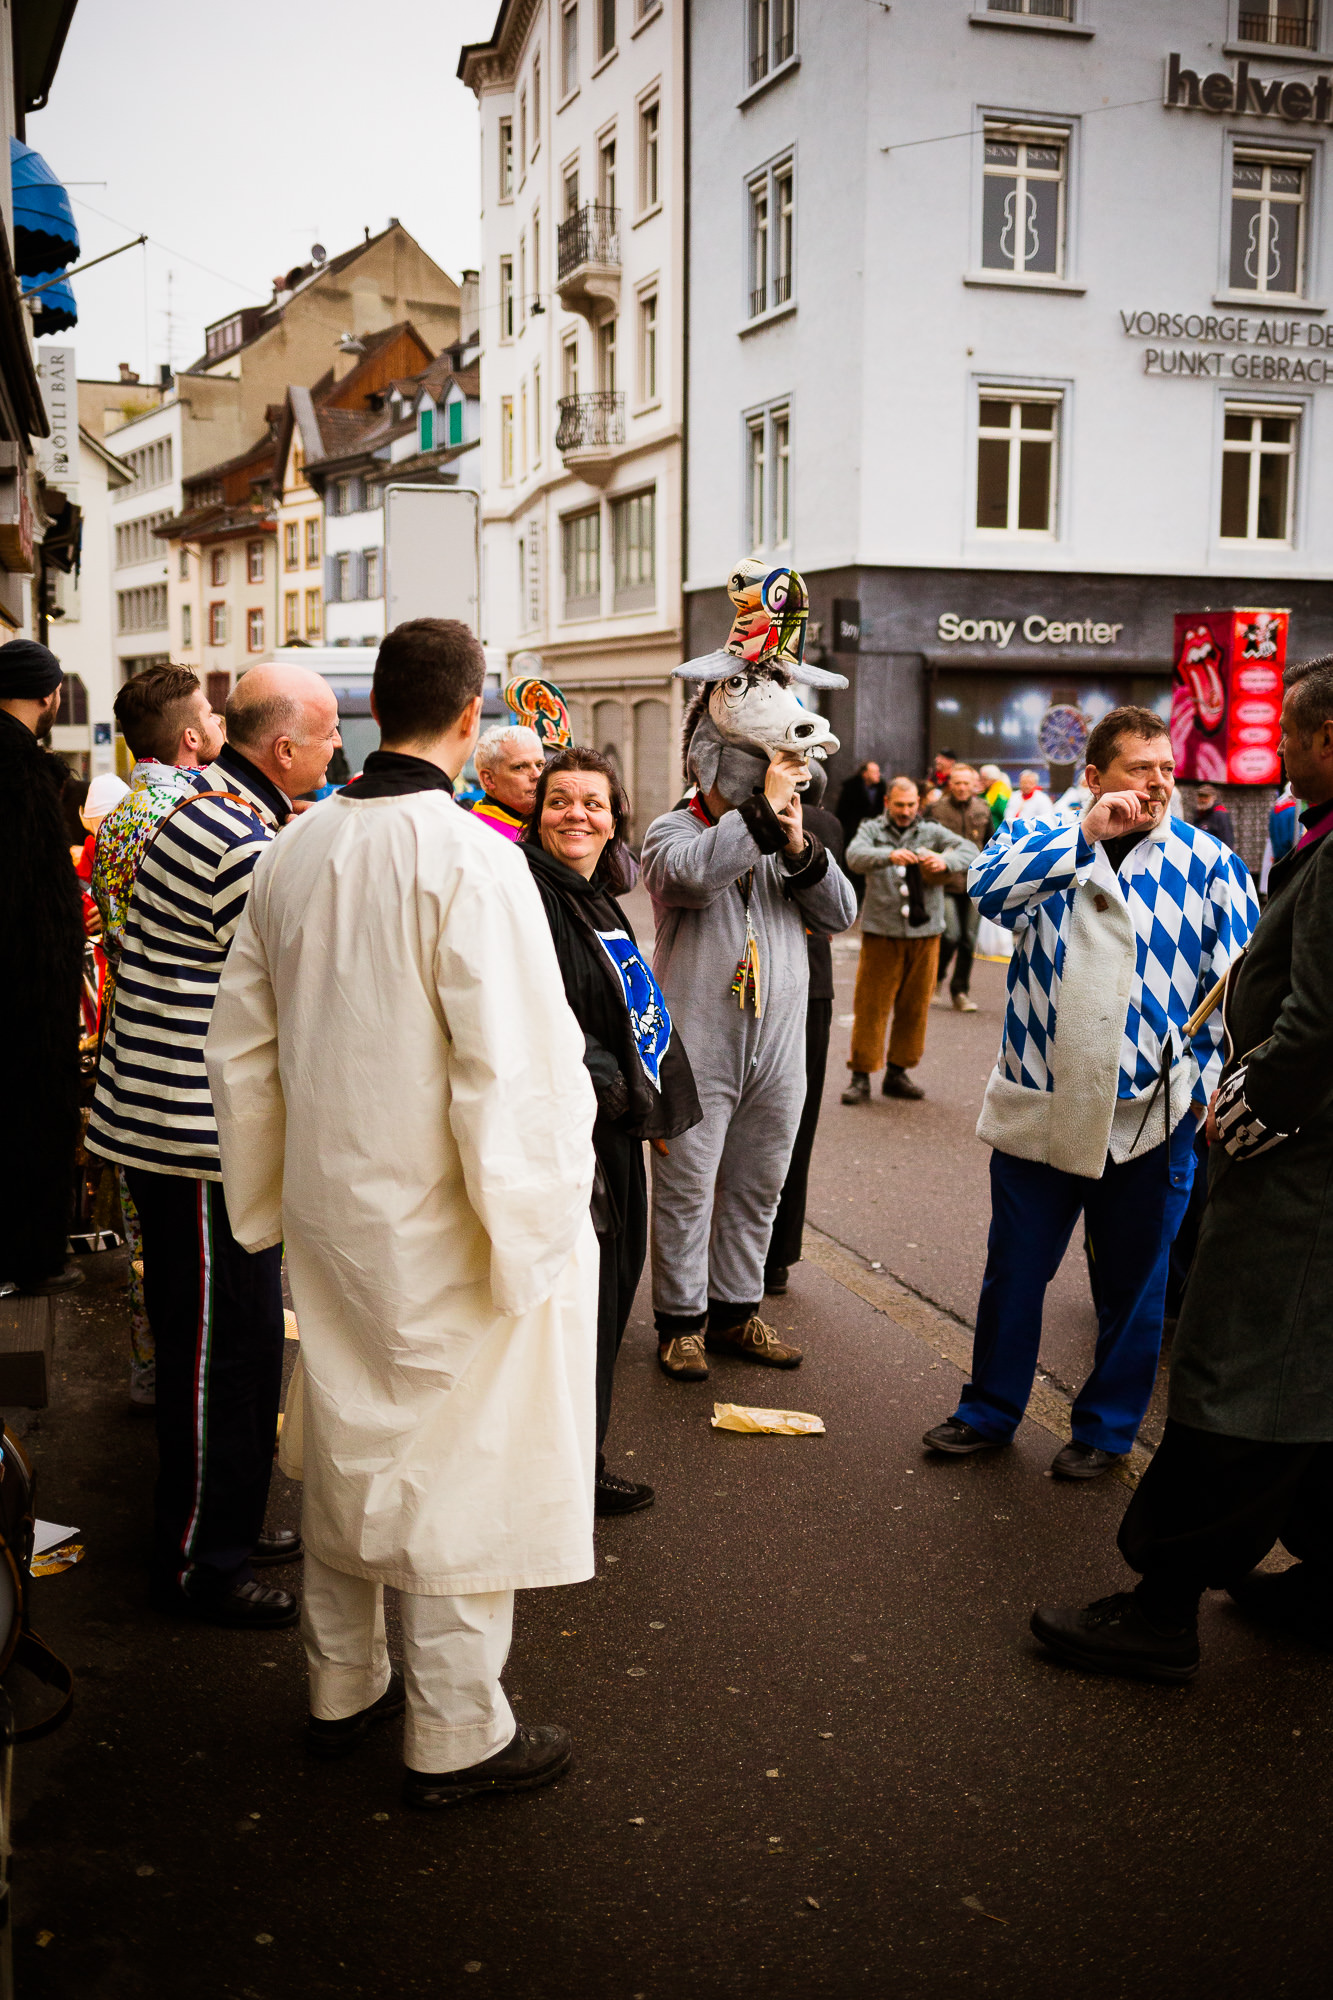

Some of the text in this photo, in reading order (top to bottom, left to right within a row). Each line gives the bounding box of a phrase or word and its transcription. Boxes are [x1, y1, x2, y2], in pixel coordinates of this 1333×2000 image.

[1120, 310, 1249, 342] VORSORGE
[1256, 319, 1302, 345] AUF
[50, 354, 66, 392] BAR
[1145, 349, 1225, 376] PUNKT
[938, 612, 1125, 649] Sony Center
